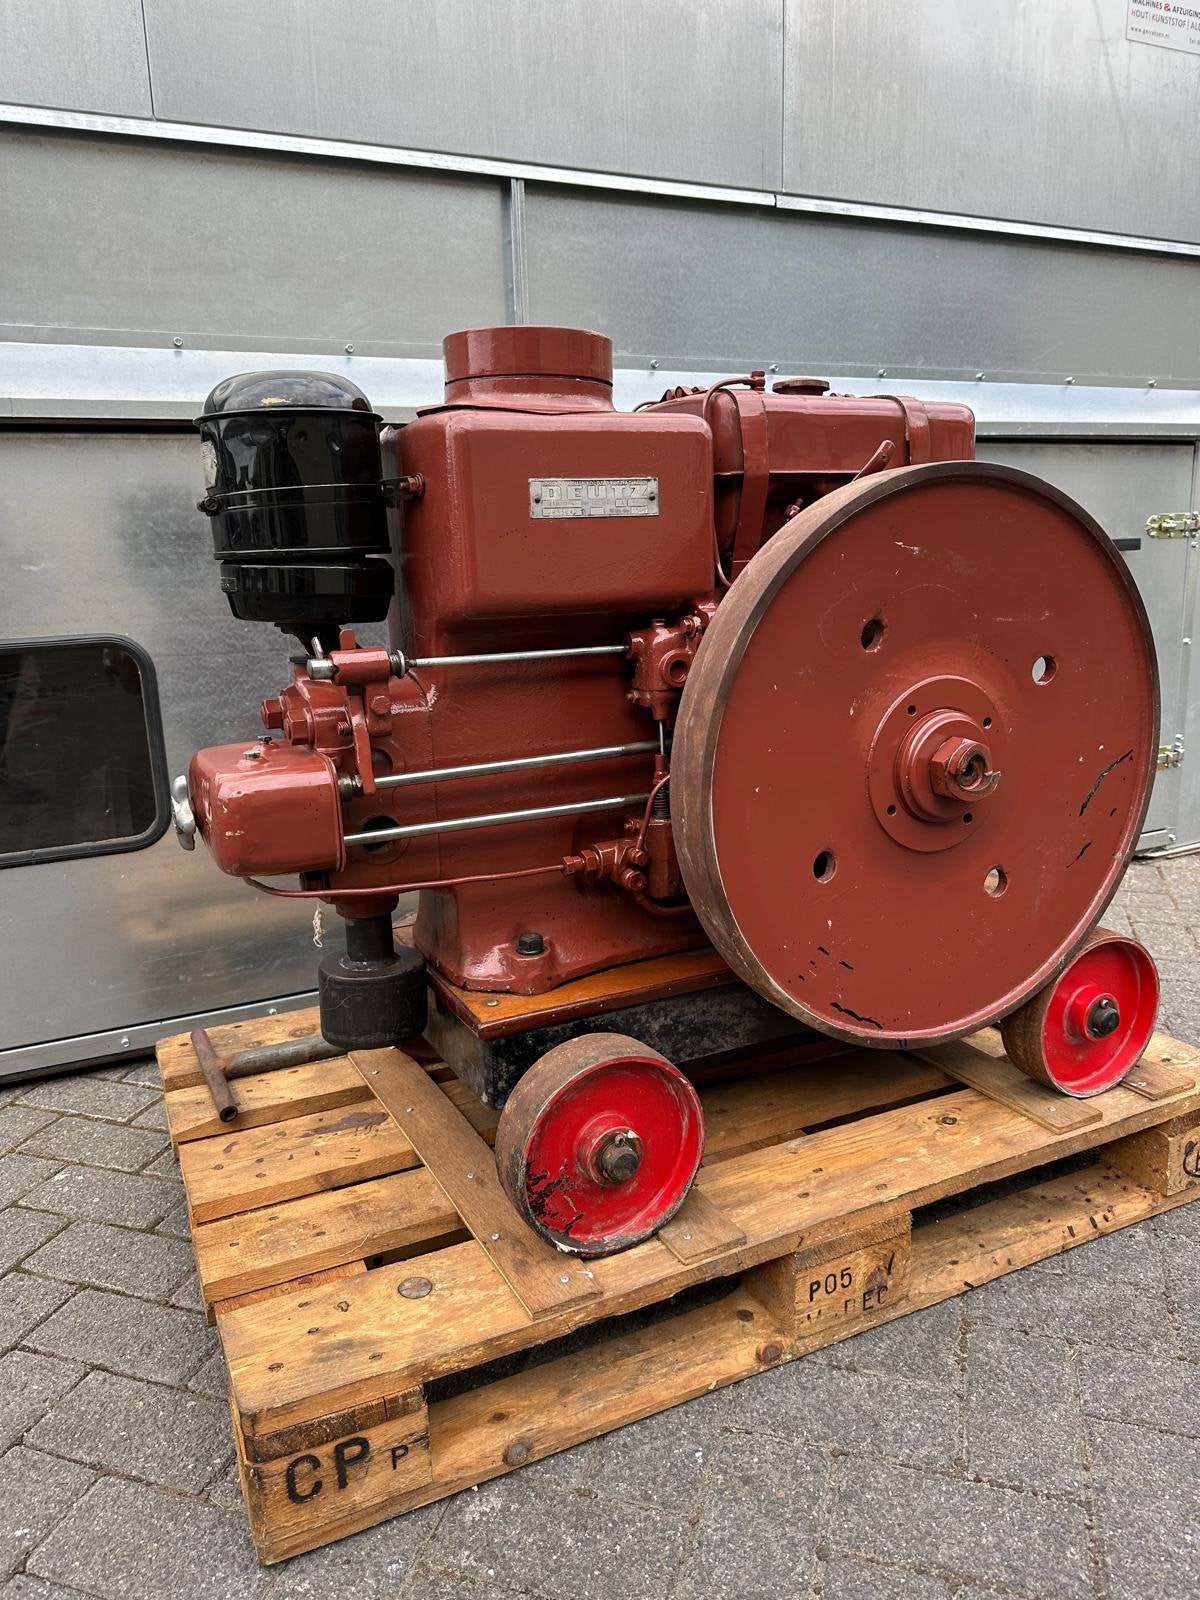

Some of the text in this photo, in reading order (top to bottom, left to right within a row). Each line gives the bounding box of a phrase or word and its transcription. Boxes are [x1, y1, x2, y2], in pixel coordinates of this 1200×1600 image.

[1164, 3, 1171, 12] &
[1131, 8, 1149, 19] HOUT
[1152, 14, 1186, 28] KUNSTSTOF
[541, 485, 649, 500] DEUTZ
[286, 1437, 409, 1504] CP P
